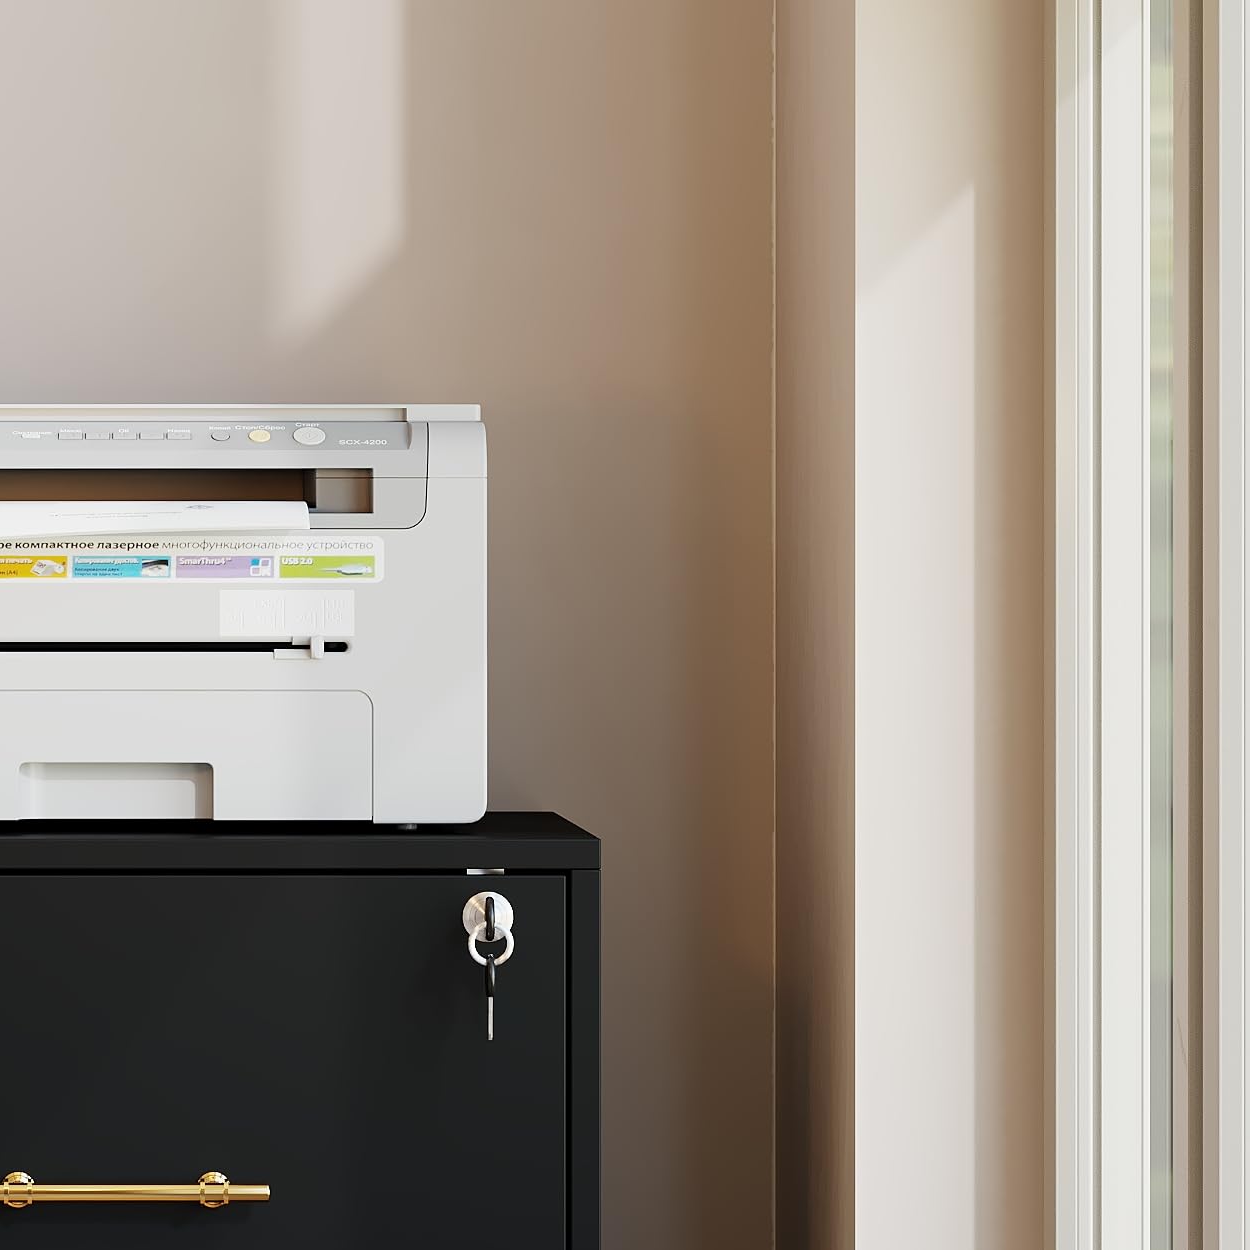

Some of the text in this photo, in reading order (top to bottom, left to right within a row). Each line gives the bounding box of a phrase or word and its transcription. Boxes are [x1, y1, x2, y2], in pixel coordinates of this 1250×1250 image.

[15, 541, 95, 550] компактное
[96, 541, 160, 552] лазерное
[161, 540, 304, 551] многофункциональное
[306, 540, 374, 552] устройство
[281, 557, 313, 566] USB 2.0
